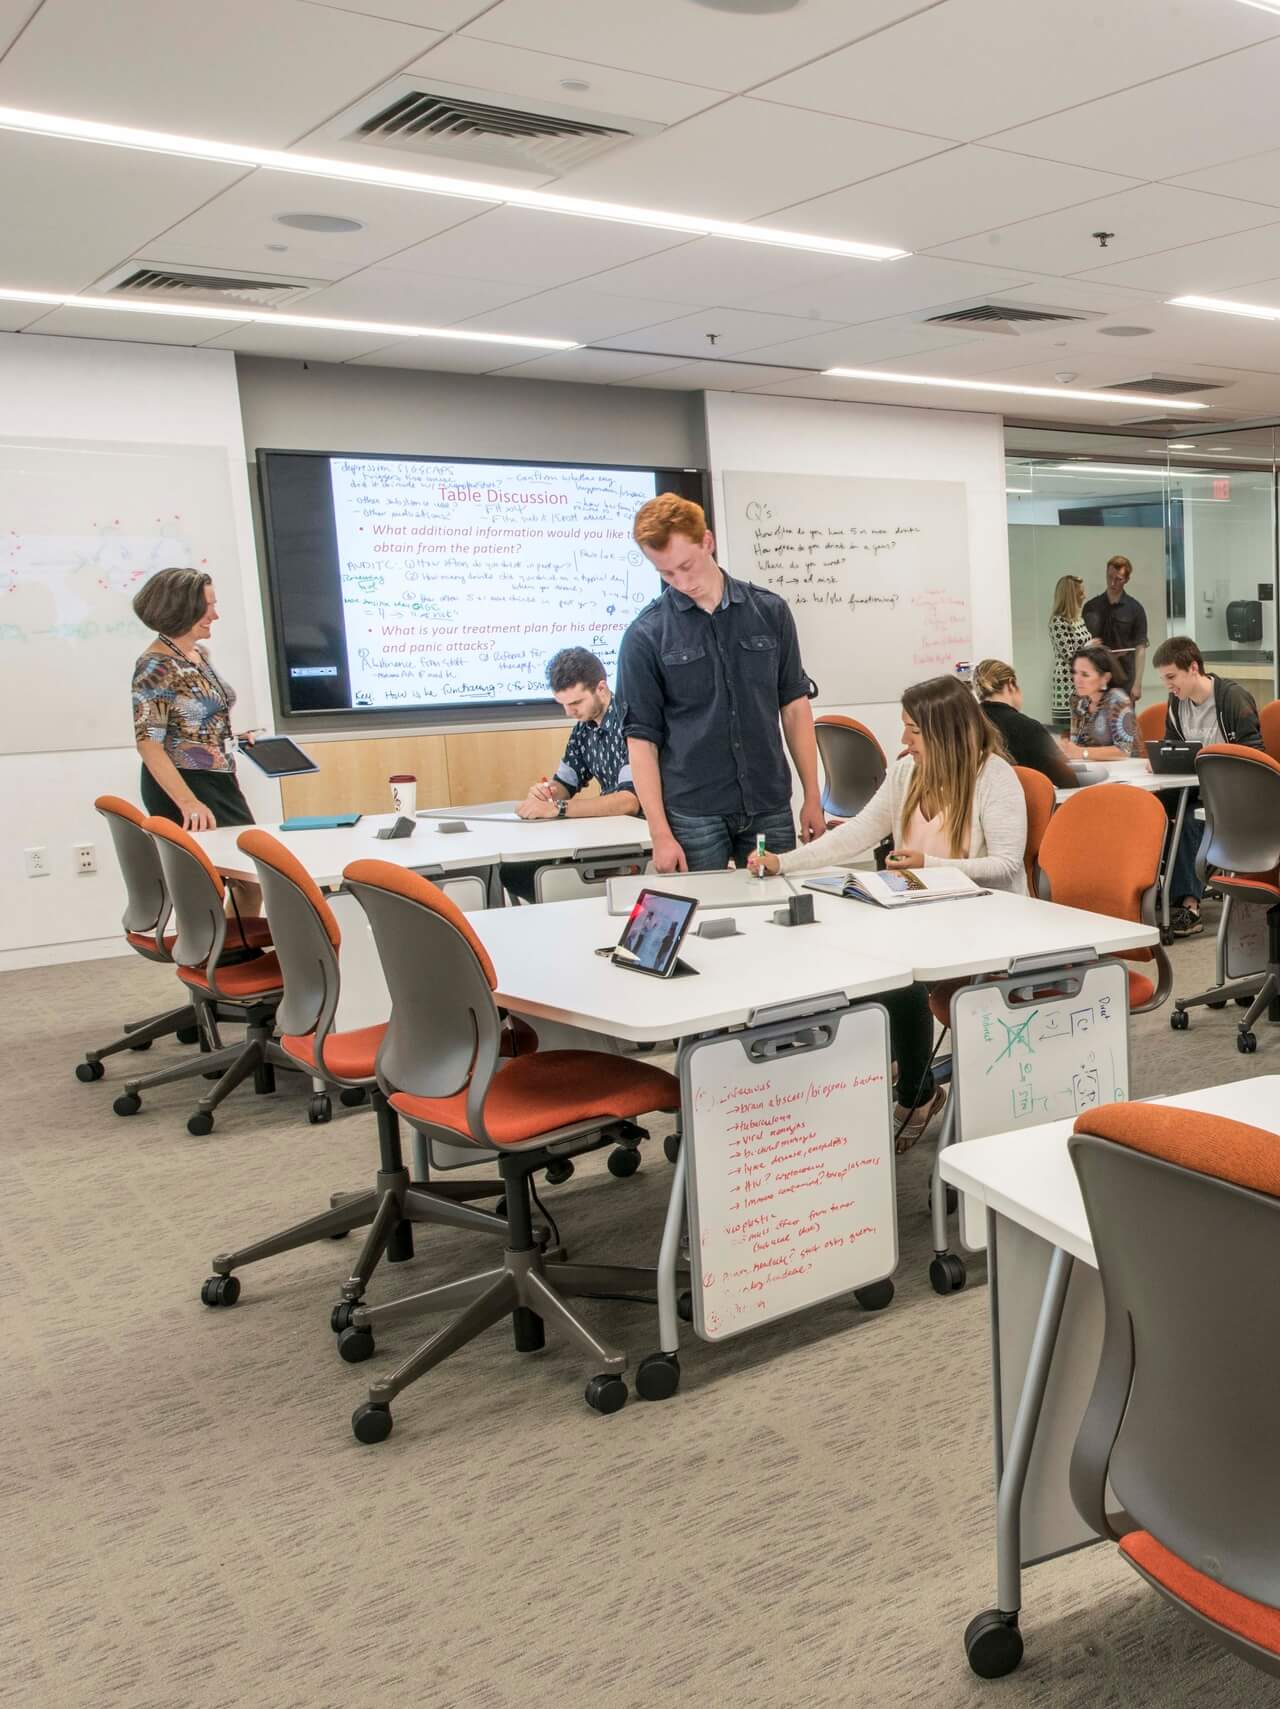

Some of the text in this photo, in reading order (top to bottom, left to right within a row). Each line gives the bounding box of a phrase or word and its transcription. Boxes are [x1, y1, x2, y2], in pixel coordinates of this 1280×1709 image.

[438, 487, 481, 502] Table
[487, 489, 568, 504] Discussion
[373, 524, 408, 536] What
[411, 525, 472, 536] additional
[476, 525, 543, 538] information
[547, 528, 580, 538] would
[584, 531, 603, 543] you
[606, 529, 624, 539] like
[373, 542, 521, 555] obtain from the patient?
[382, 622, 630, 639] What is your treatment plan for his depress
[382, 639, 496, 654] and panic attacks?
